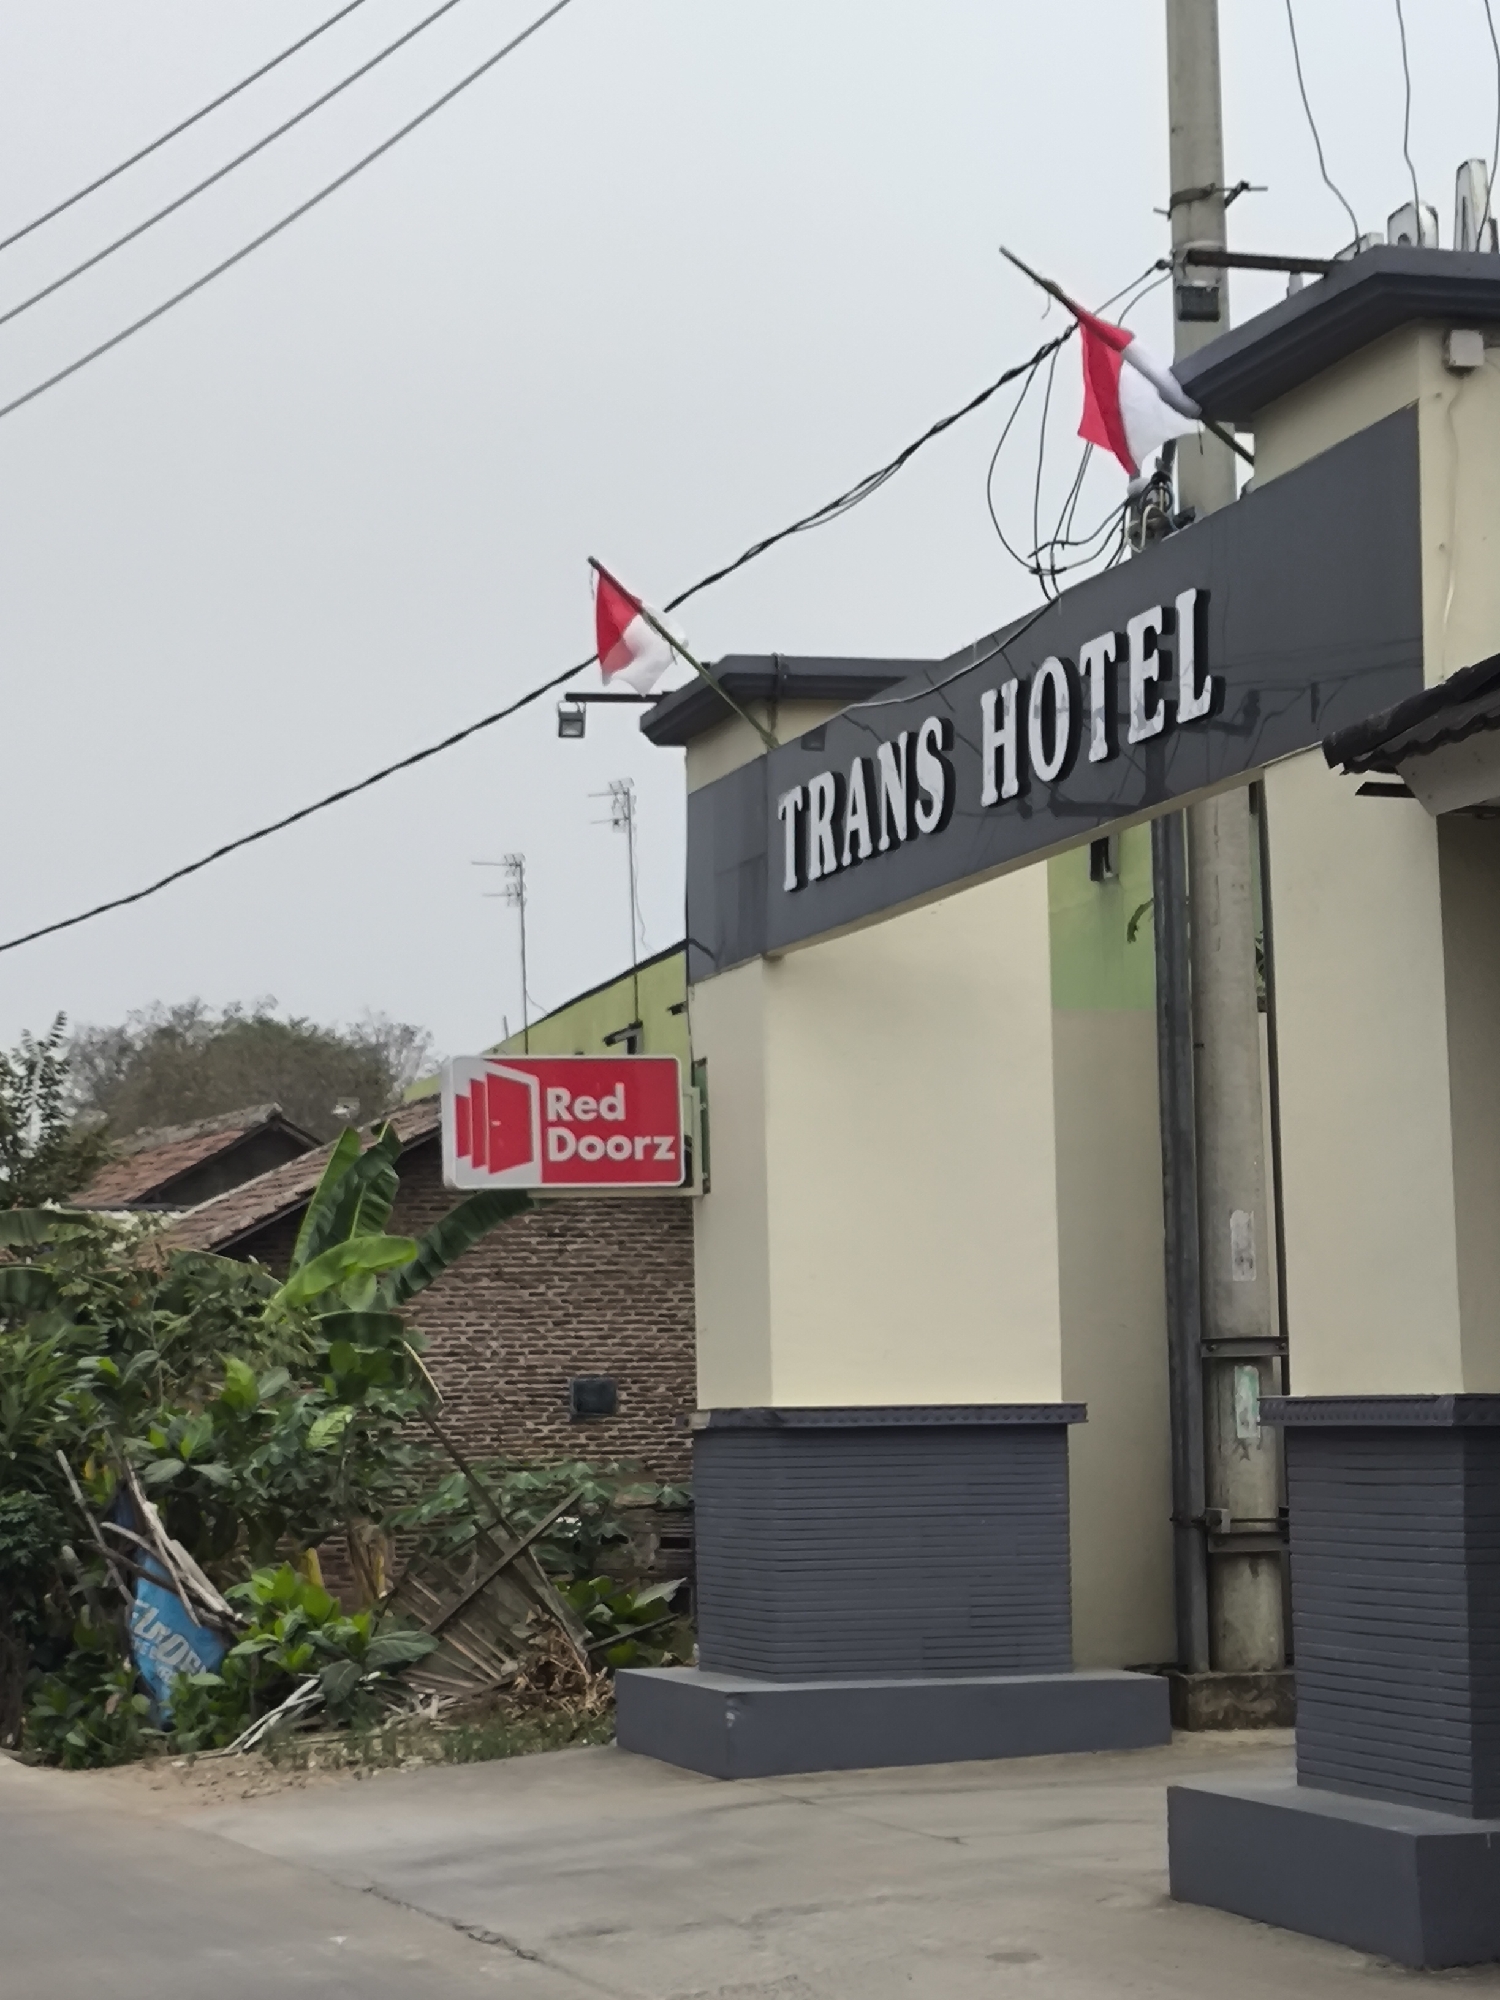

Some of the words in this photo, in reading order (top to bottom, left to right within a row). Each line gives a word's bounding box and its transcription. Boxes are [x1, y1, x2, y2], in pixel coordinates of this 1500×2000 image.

[778, 715, 948, 893] TRANS
[980, 587, 1213, 808] HOTEL
[546, 1082, 626, 1122] Red
[547, 1126, 676, 1162] Doorz
